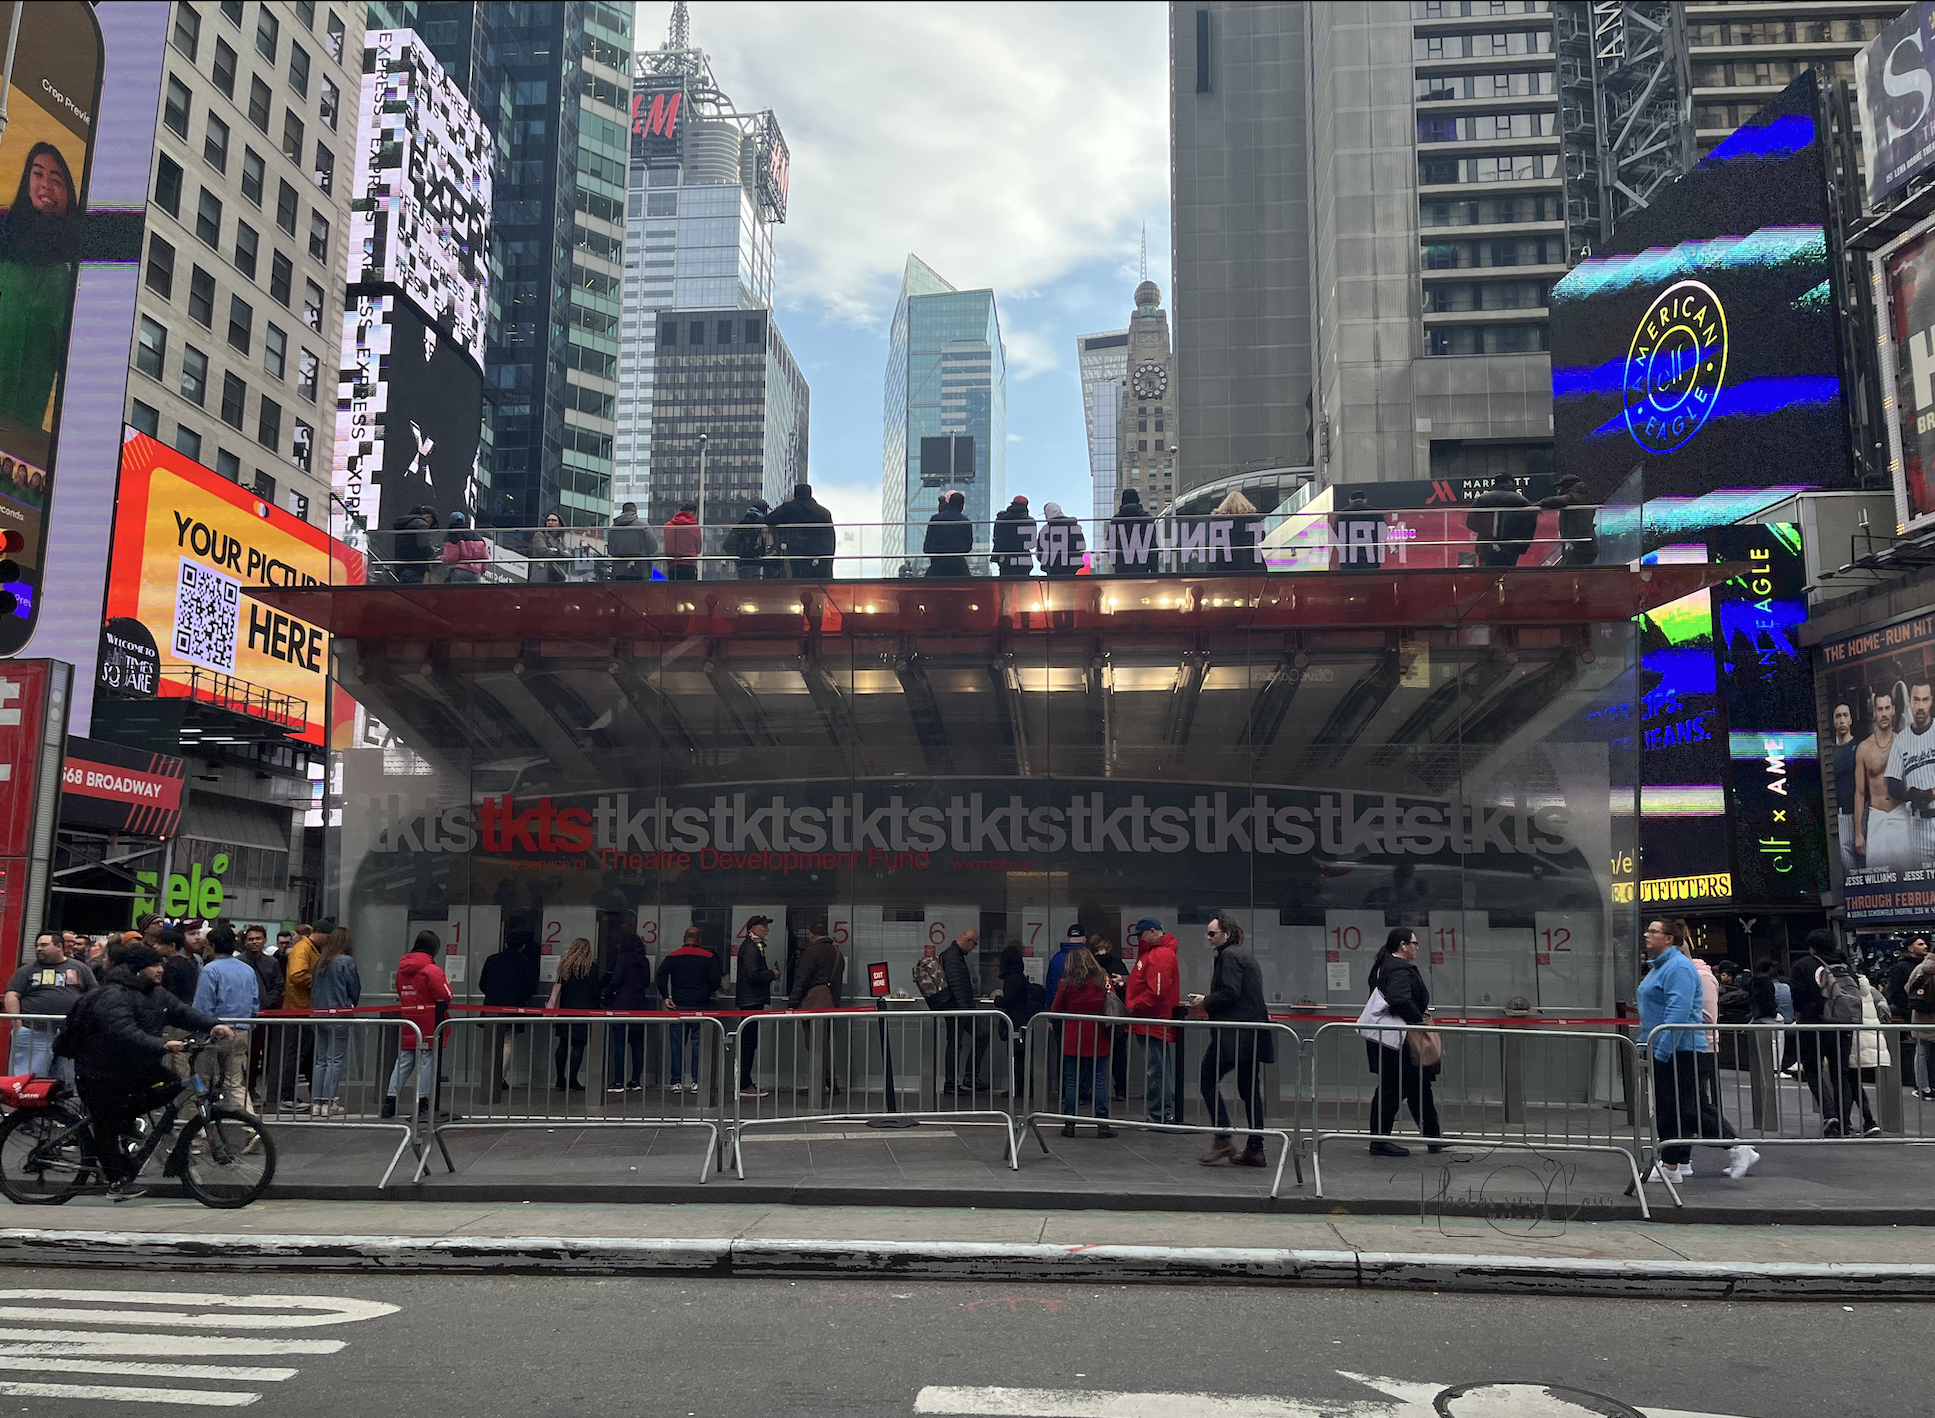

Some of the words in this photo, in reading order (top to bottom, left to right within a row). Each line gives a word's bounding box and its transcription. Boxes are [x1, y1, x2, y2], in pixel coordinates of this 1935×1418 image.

[373, 32, 393, 116] EXPRESS
[41, 78, 64, 103] Crop
[64, 96, 91, 126] Previe
[1632, 295, 1718, 391] AMERICAN
[1645, 386, 1708, 441] EAGLE
[173, 509, 243, 575] YOUR
[246, 546, 332, 587] PICTU
[1750, 548, 1775, 630] EAGLE
[106, 632, 145, 654] WELCOME
[145, 647, 155, 658] TO
[248, 602, 324, 675] HERE
[1824, 643, 1846, 664] THE
[1848, 623, 1911, 657] HOME-RUN
[1913, 617, 1933, 638] HIT
[126, 655, 154, 674] TIMES
[85, 770, 162, 798] BROADWAY
[509, 860, 522, 870] a
[523, 858, 571, 870] service
[574, 857, 588, 870] of
[599, 847, 691, 870] Theatre
[700, 847, 860, 875] Development
[868, 847, 930, 870] Fund
[1844, 875, 1864, 887] JESSE
[1864, 872, 1897, 884] WILLIAMS
[1903, 870, 1925, 881] JESSE
[1625, 876, 1731, 902] OTFITTERS
[1845, 893, 1892, 910] THROUGH
[452, 921, 461, 943] 1
[546, 921, 561, 943] 2
[641, 921, 657, 944] 3
[833, 921, 849, 944] 5
[929, 921, 946, 945] 6
[1026, 922, 1043, 944] 7
[1330, 926, 1361, 950] 10
[1435, 927, 1458, 950] 11
[1540, 927, 1571, 952] 12
